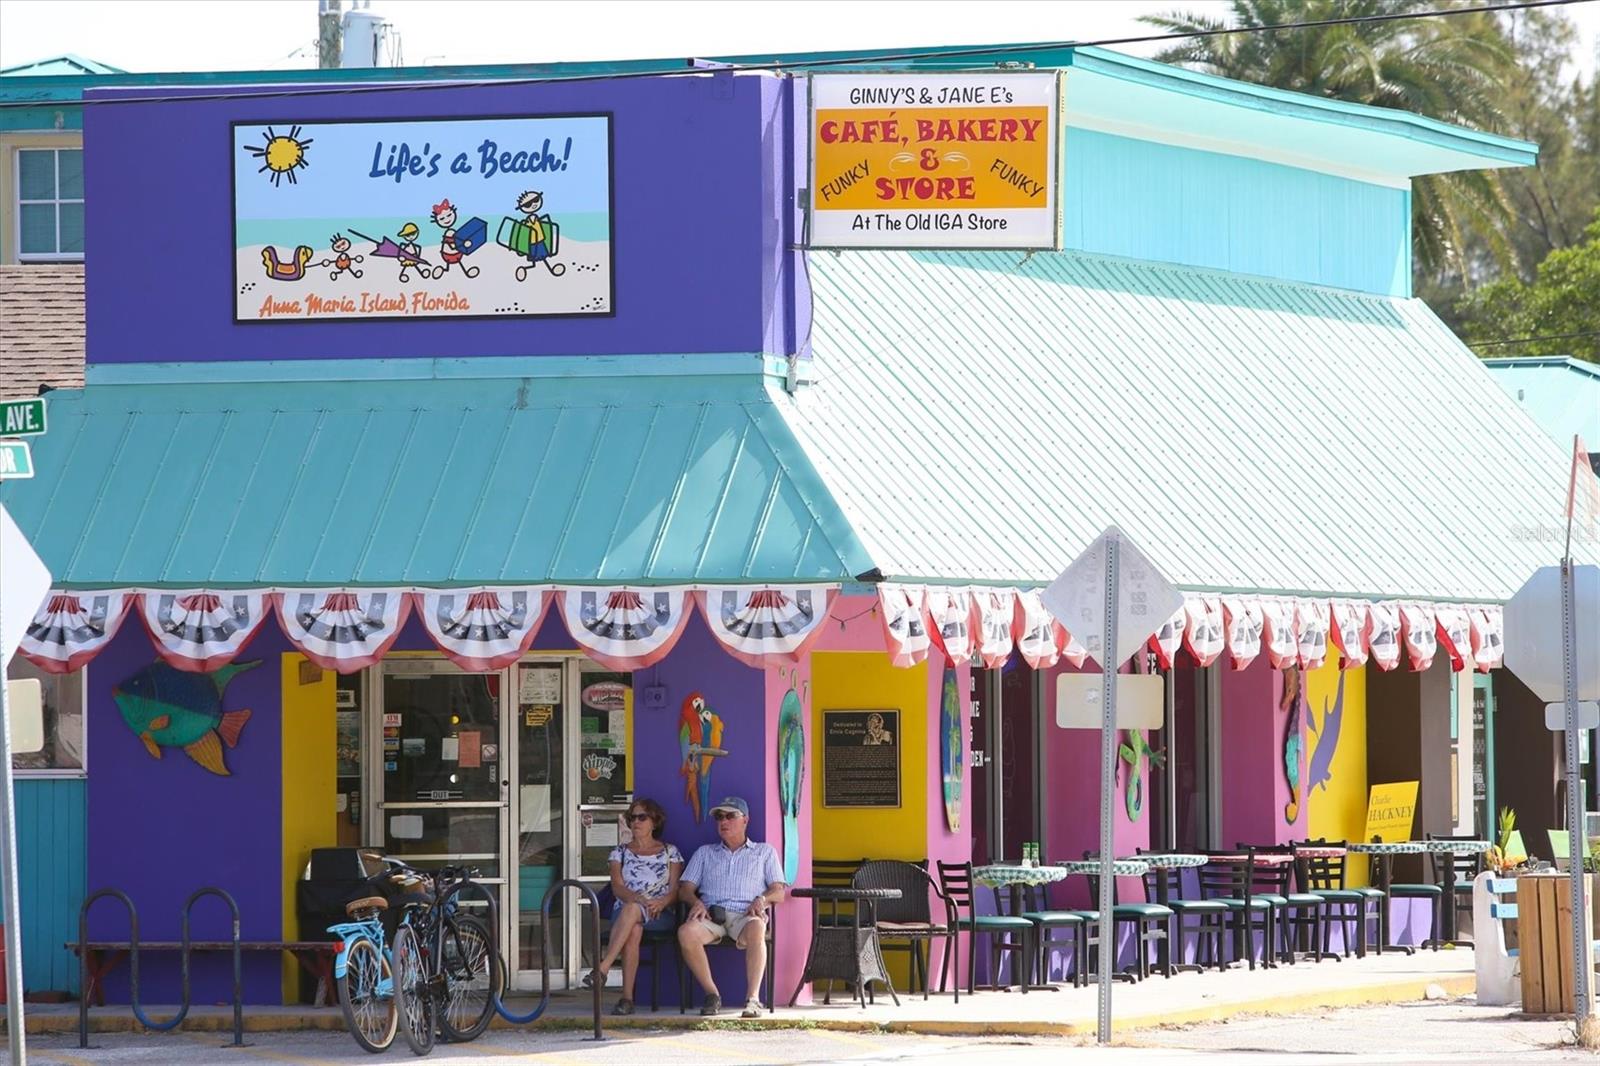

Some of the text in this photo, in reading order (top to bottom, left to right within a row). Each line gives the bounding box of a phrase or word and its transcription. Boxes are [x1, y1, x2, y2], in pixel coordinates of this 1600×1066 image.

[850, 86, 1014, 105] GINNY'S & JANE E's
[820, 111, 1043, 148] CAFÉ, BAKERY
[368, 137, 573, 184] Life's a Beach!
[919, 147, 940, 172] &
[820, 159, 872, 202] FUNKY
[875, 176, 977, 201] STORE
[990, 158, 1044, 198] FUNKY
[852, 213, 1008, 231] At The Old IGA Store
[259, 291, 470, 317] Anna Maria Island, Florida
[6, 404, 39, 432] AVE.
[1368, 806, 1414, 822] HACKNEY
